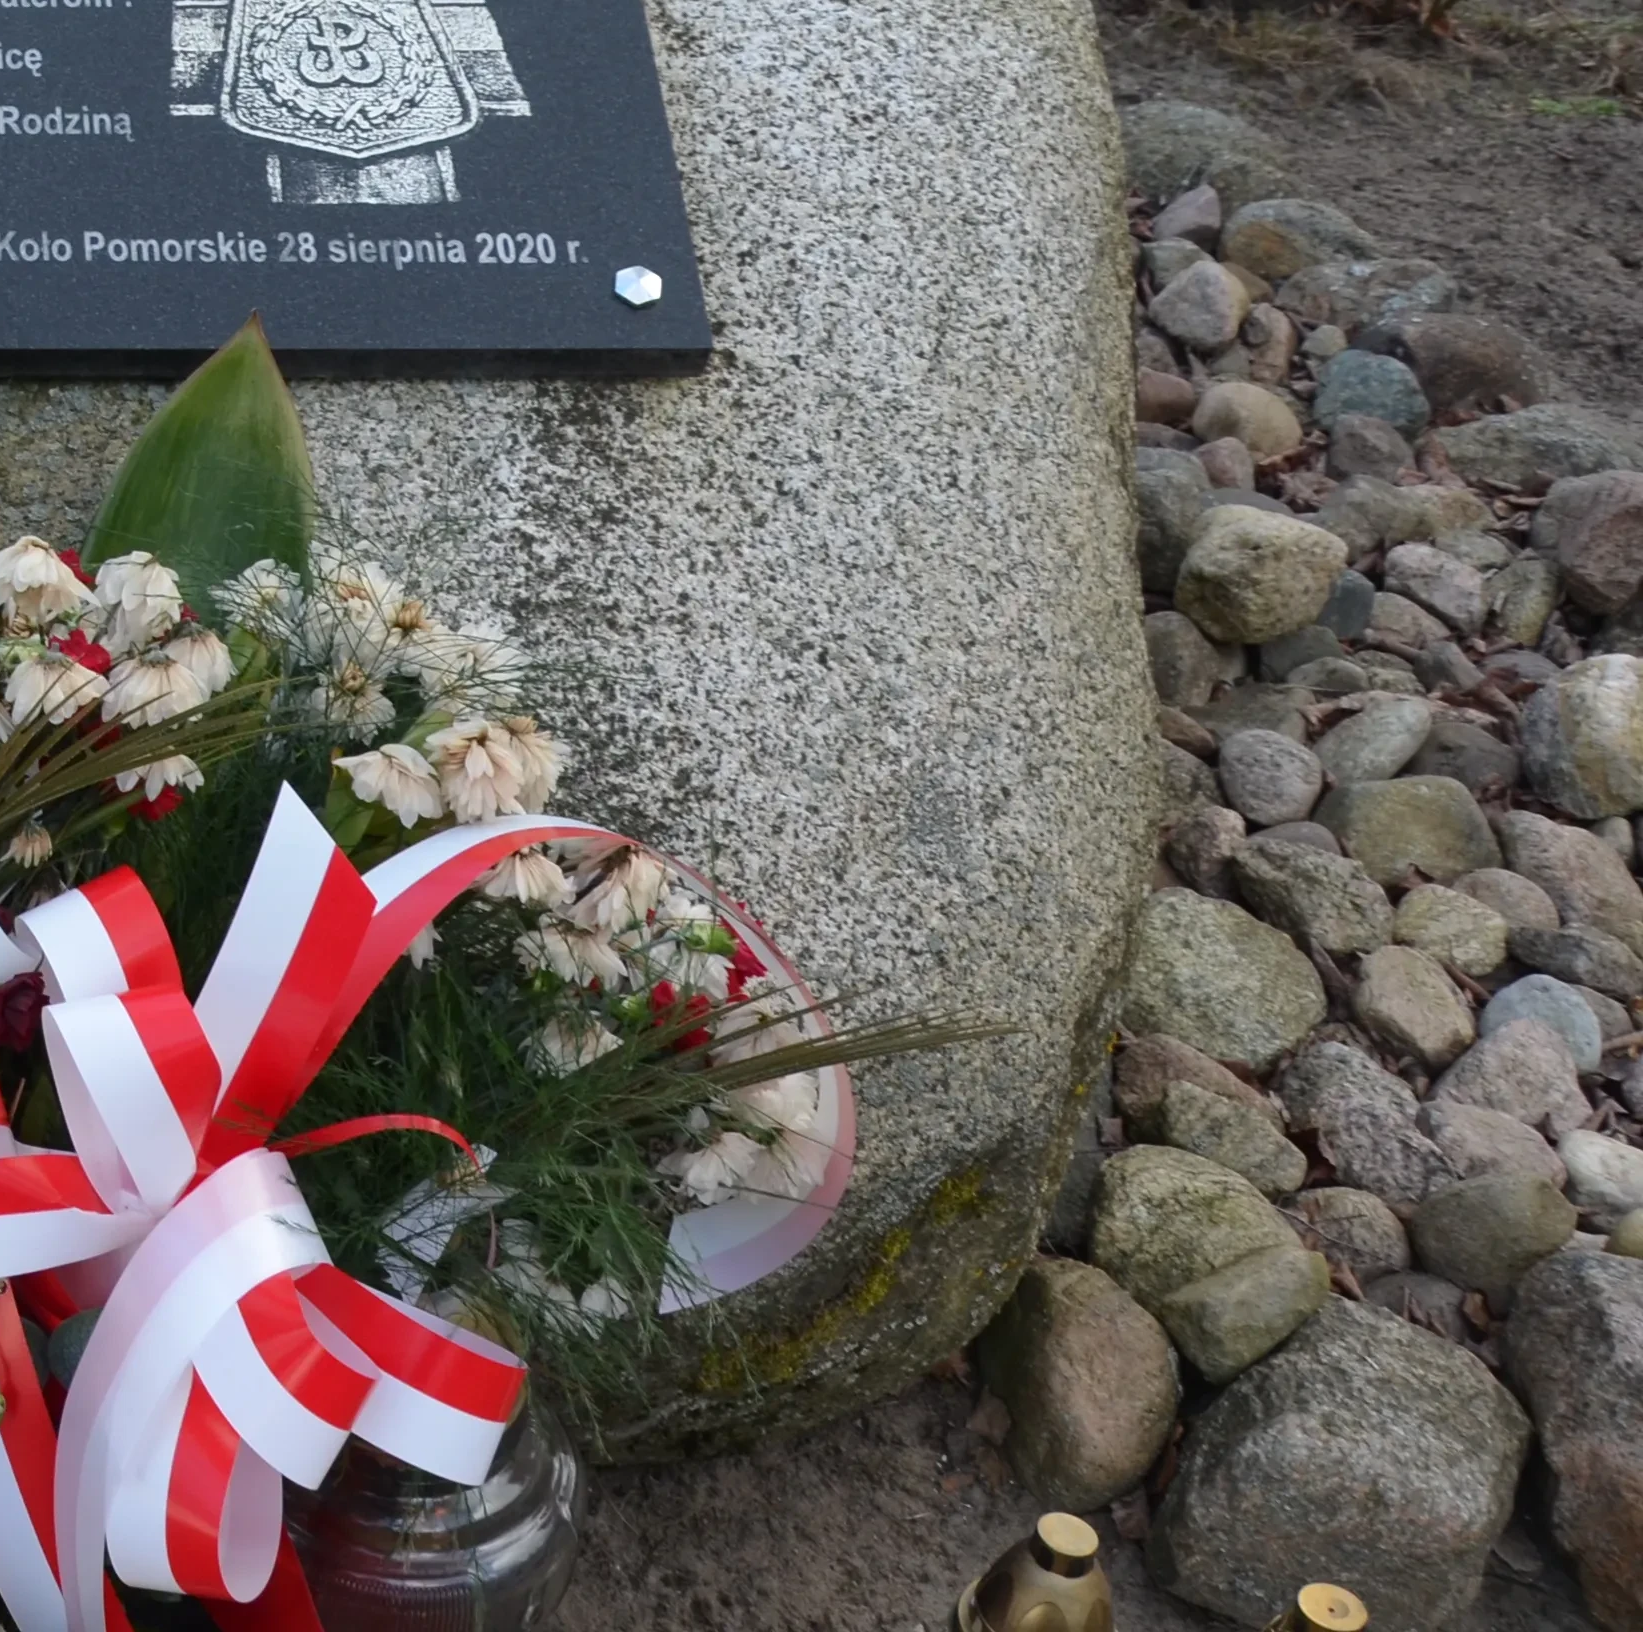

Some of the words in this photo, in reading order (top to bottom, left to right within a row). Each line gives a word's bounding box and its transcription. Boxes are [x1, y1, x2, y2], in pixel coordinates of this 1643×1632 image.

[83, 230, 268, 263] Pomorskie
[276, 231, 318, 264] 28
[327, 231, 468, 271] sierpnia
[474, 231, 557, 265] 2020
[566, 240, 589, 264] r.
